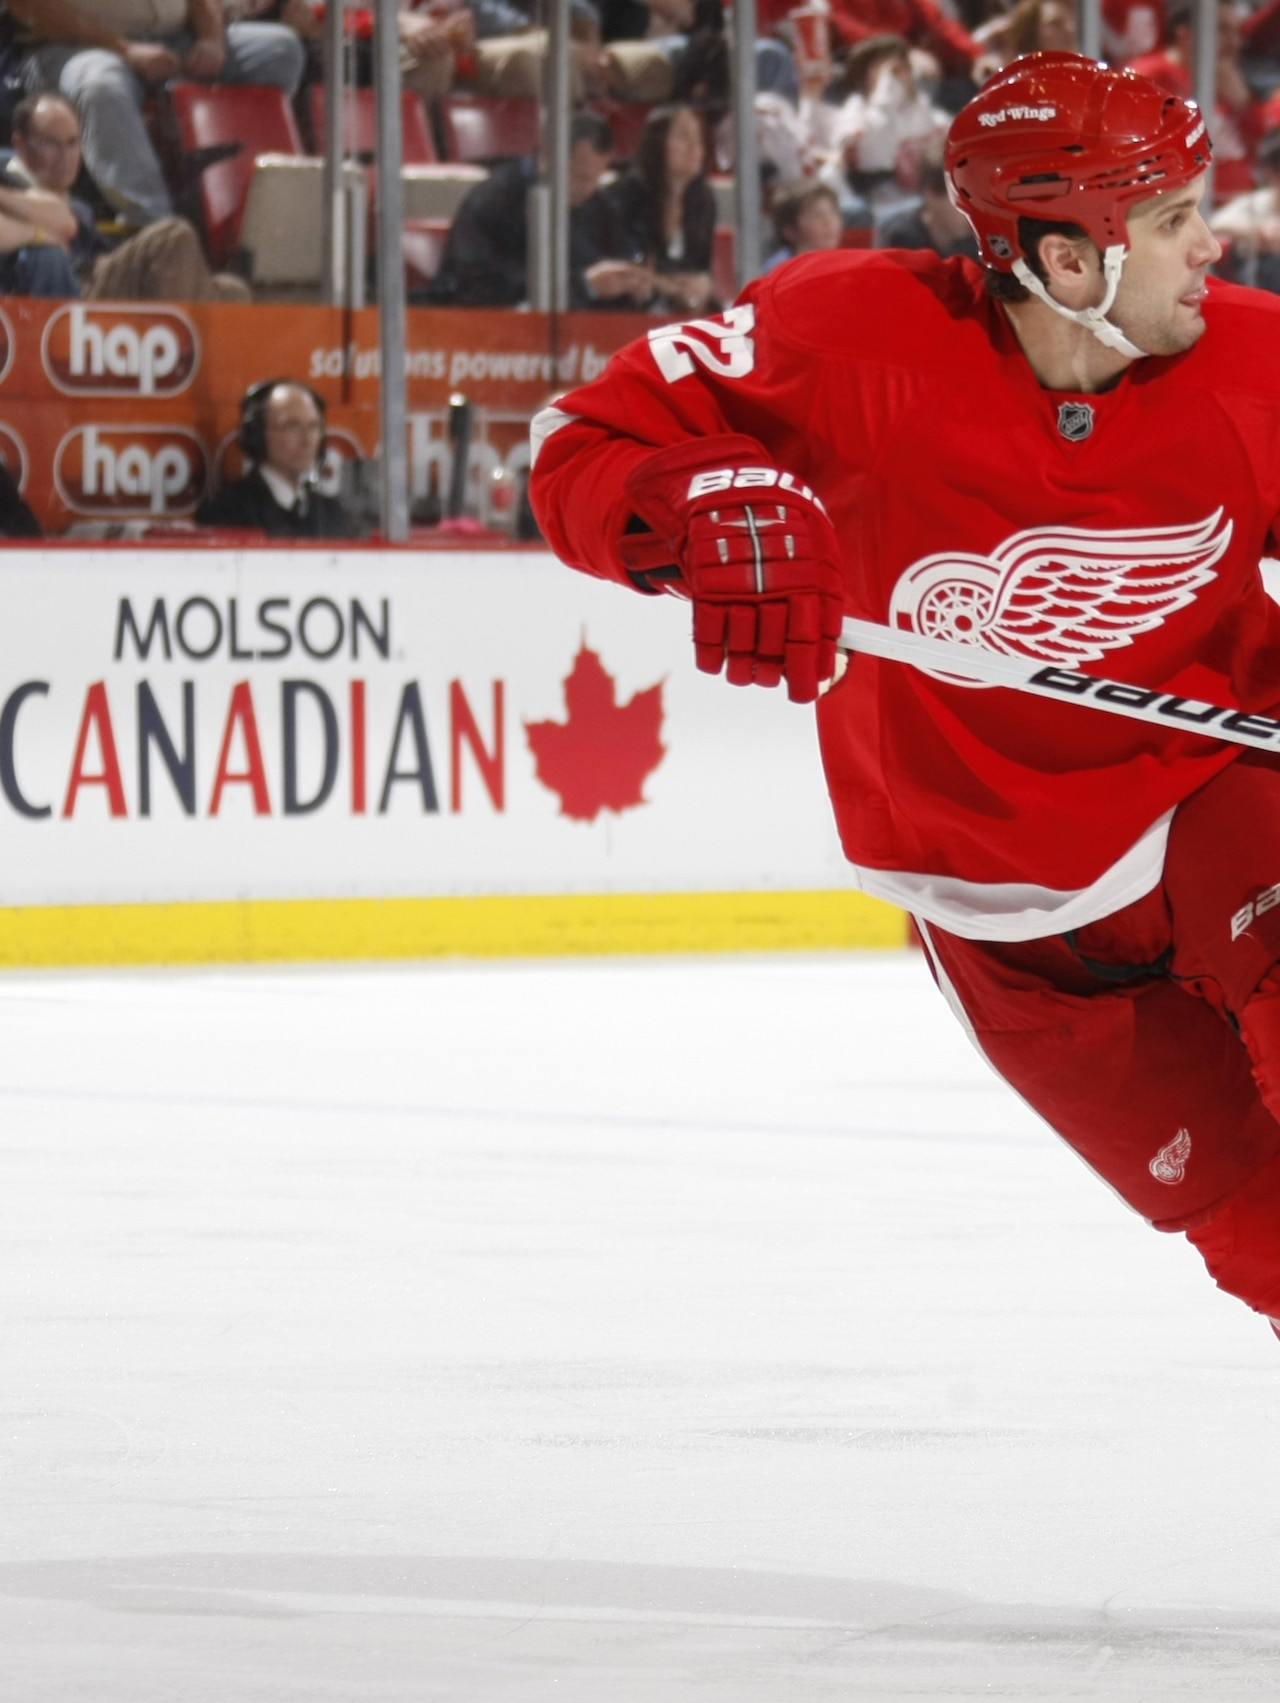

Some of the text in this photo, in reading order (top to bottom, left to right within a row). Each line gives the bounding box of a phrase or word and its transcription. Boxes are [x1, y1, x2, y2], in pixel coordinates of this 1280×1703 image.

[978, 106, 1056, 127] Red Wings
[70, 305, 179, 395] hap
[648, 303, 755, 384] 22
[82, 425, 190, 514] hap
[113, 596, 392, 661] MOLSON
[0, 678, 507, 820] CANADIAN
